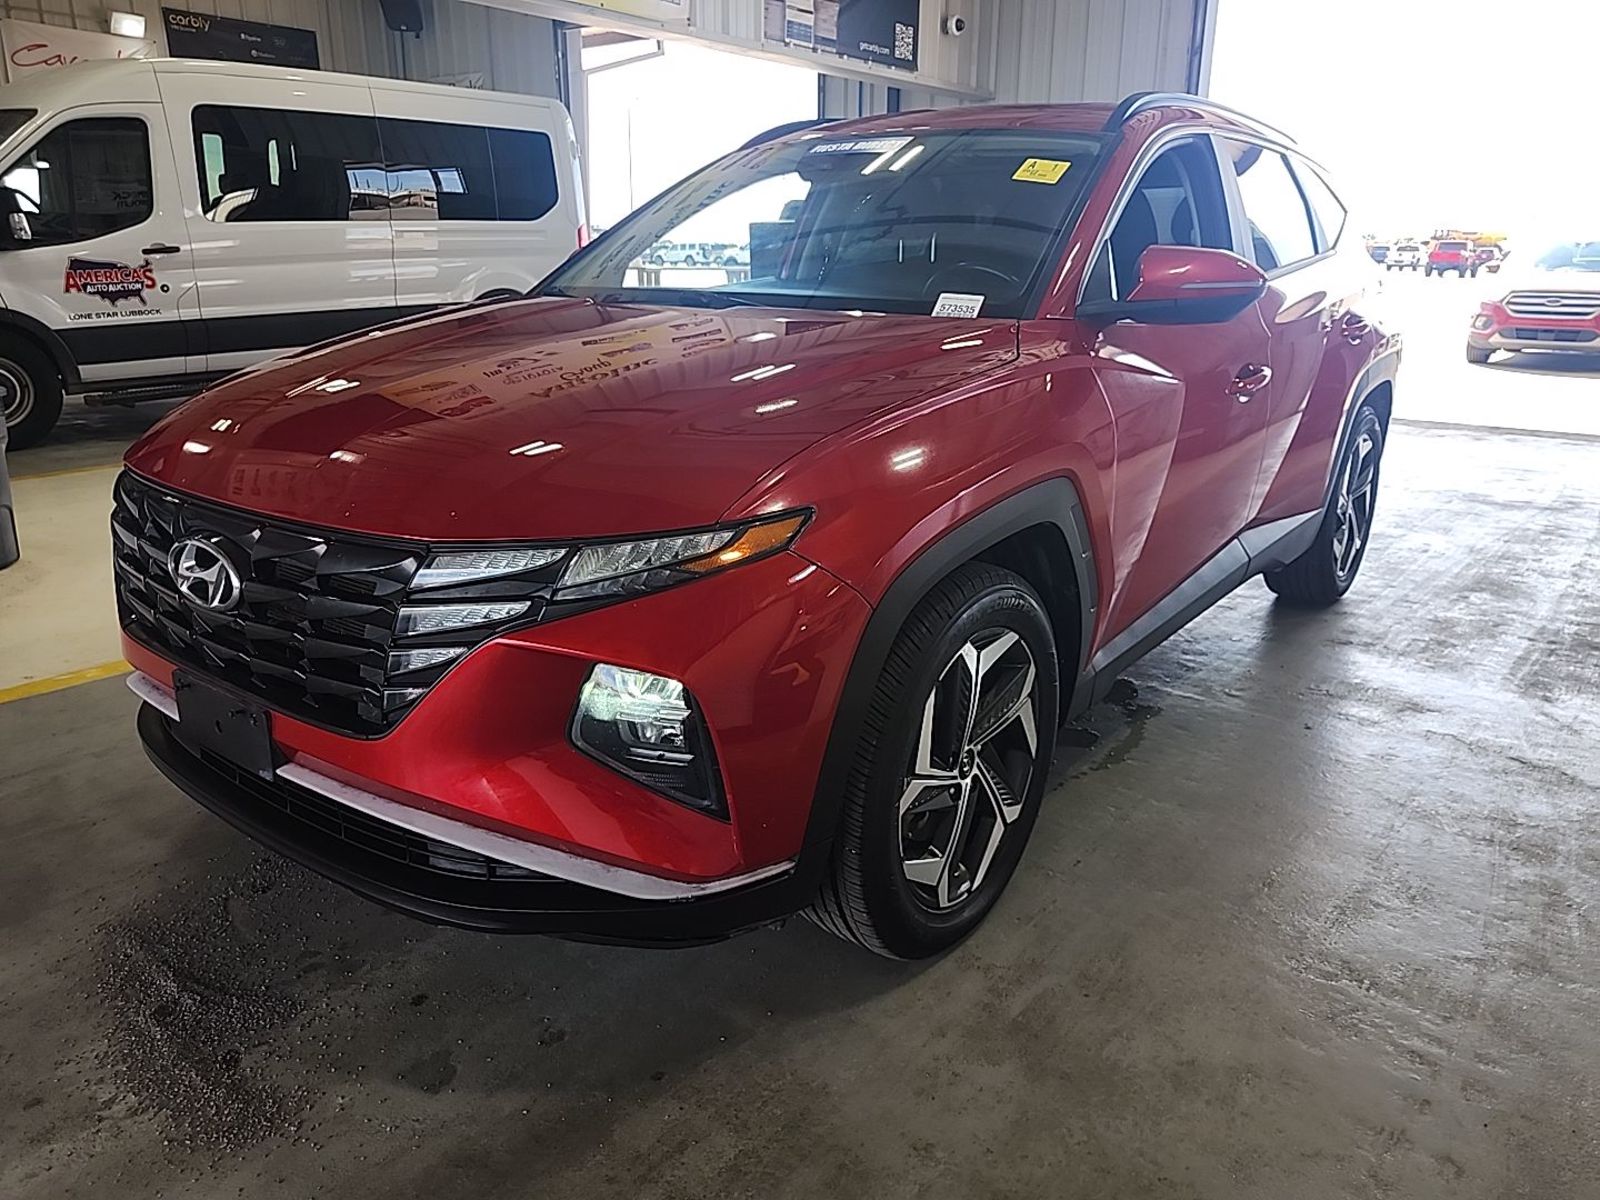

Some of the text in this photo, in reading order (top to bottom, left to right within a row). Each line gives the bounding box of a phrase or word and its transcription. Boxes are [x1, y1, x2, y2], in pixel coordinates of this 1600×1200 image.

[169, 14, 210, 32] carbly
[64, 268, 157, 294] AMERICA'S
[86, 282, 142, 293] AUTO AUCTION
[68, 308, 162, 321] LONE STAR LUBBOCK
[939, 303, 977, 314] 573535
